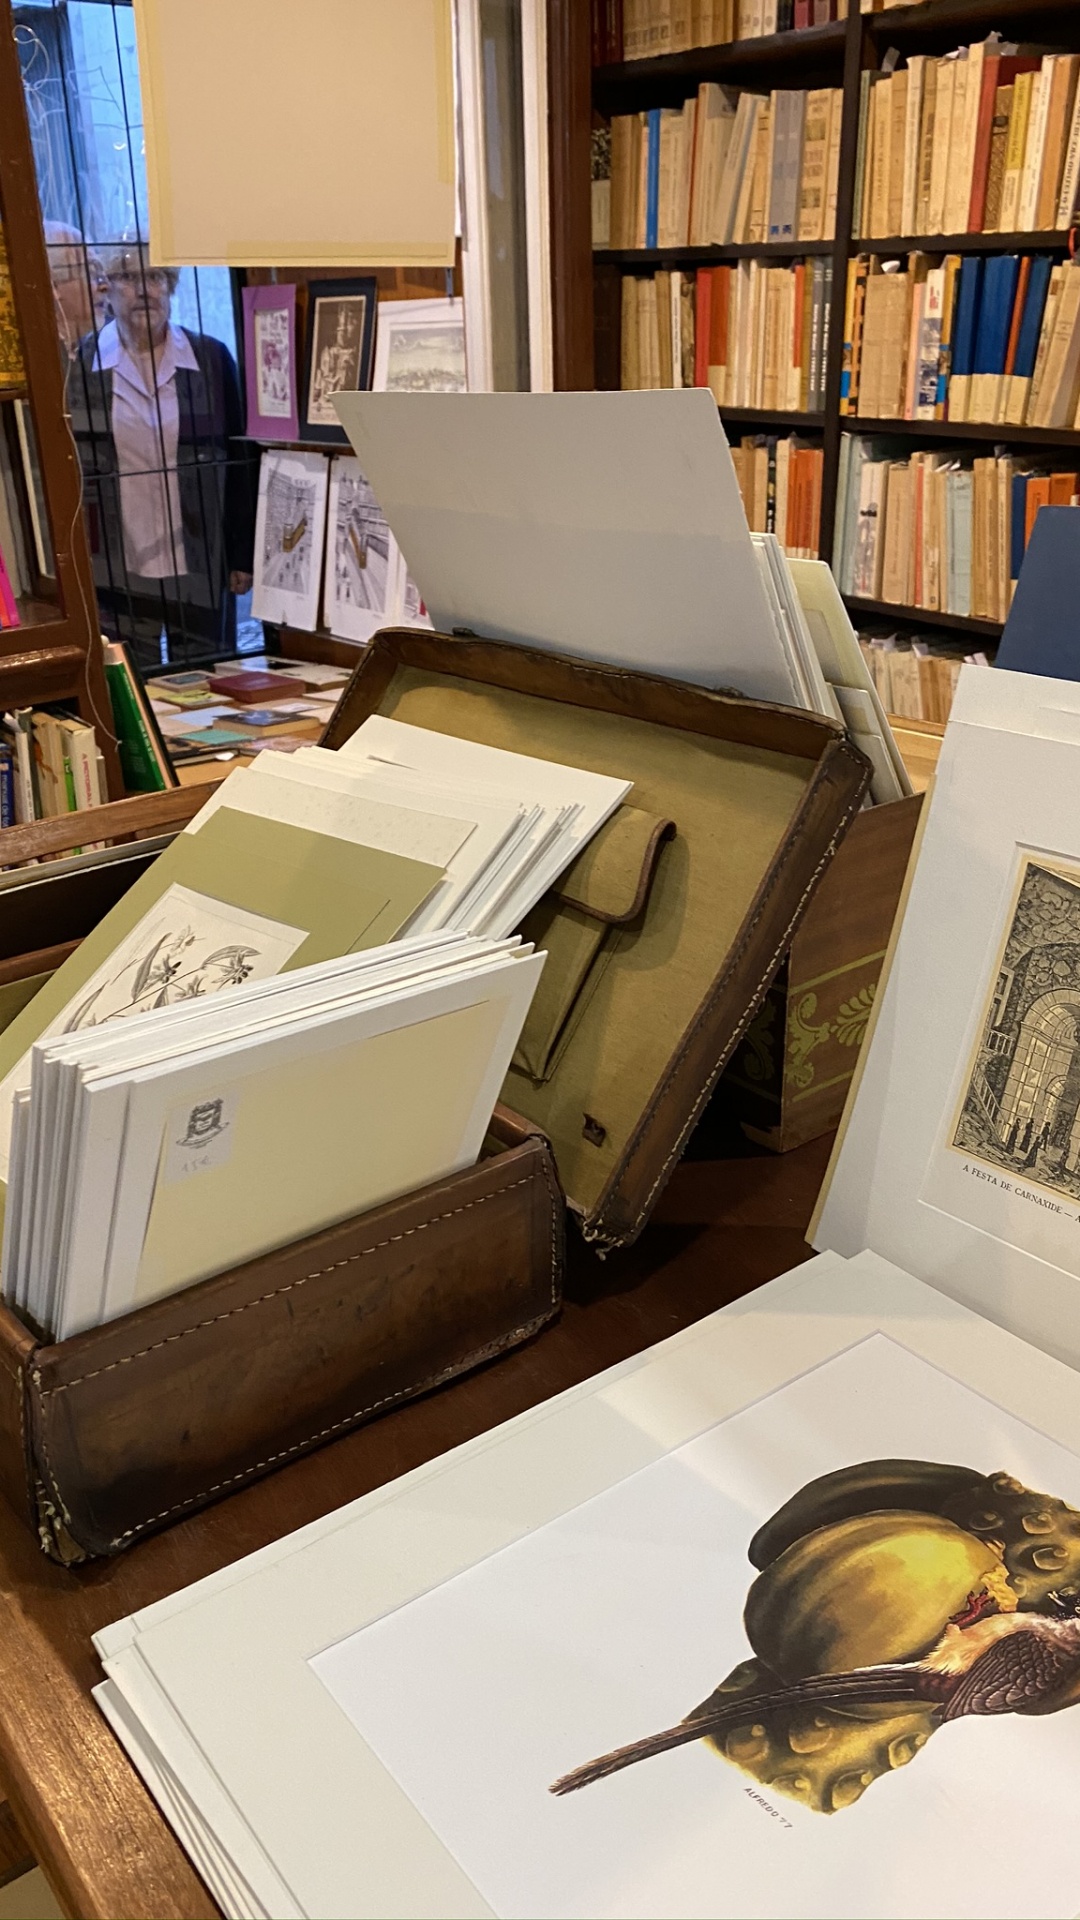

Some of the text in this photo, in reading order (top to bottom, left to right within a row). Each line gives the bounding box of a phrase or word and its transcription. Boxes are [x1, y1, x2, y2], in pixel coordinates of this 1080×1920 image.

[962, 1164, 969, 1172] A
[971, 1168, 998, 1186] FESTA
[1000, 1180, 1012, 1192] DE
[1014, 1187, 1063, 1214] CARNAXIDE
[743, 1787, 779, 1817] ALFREDO
